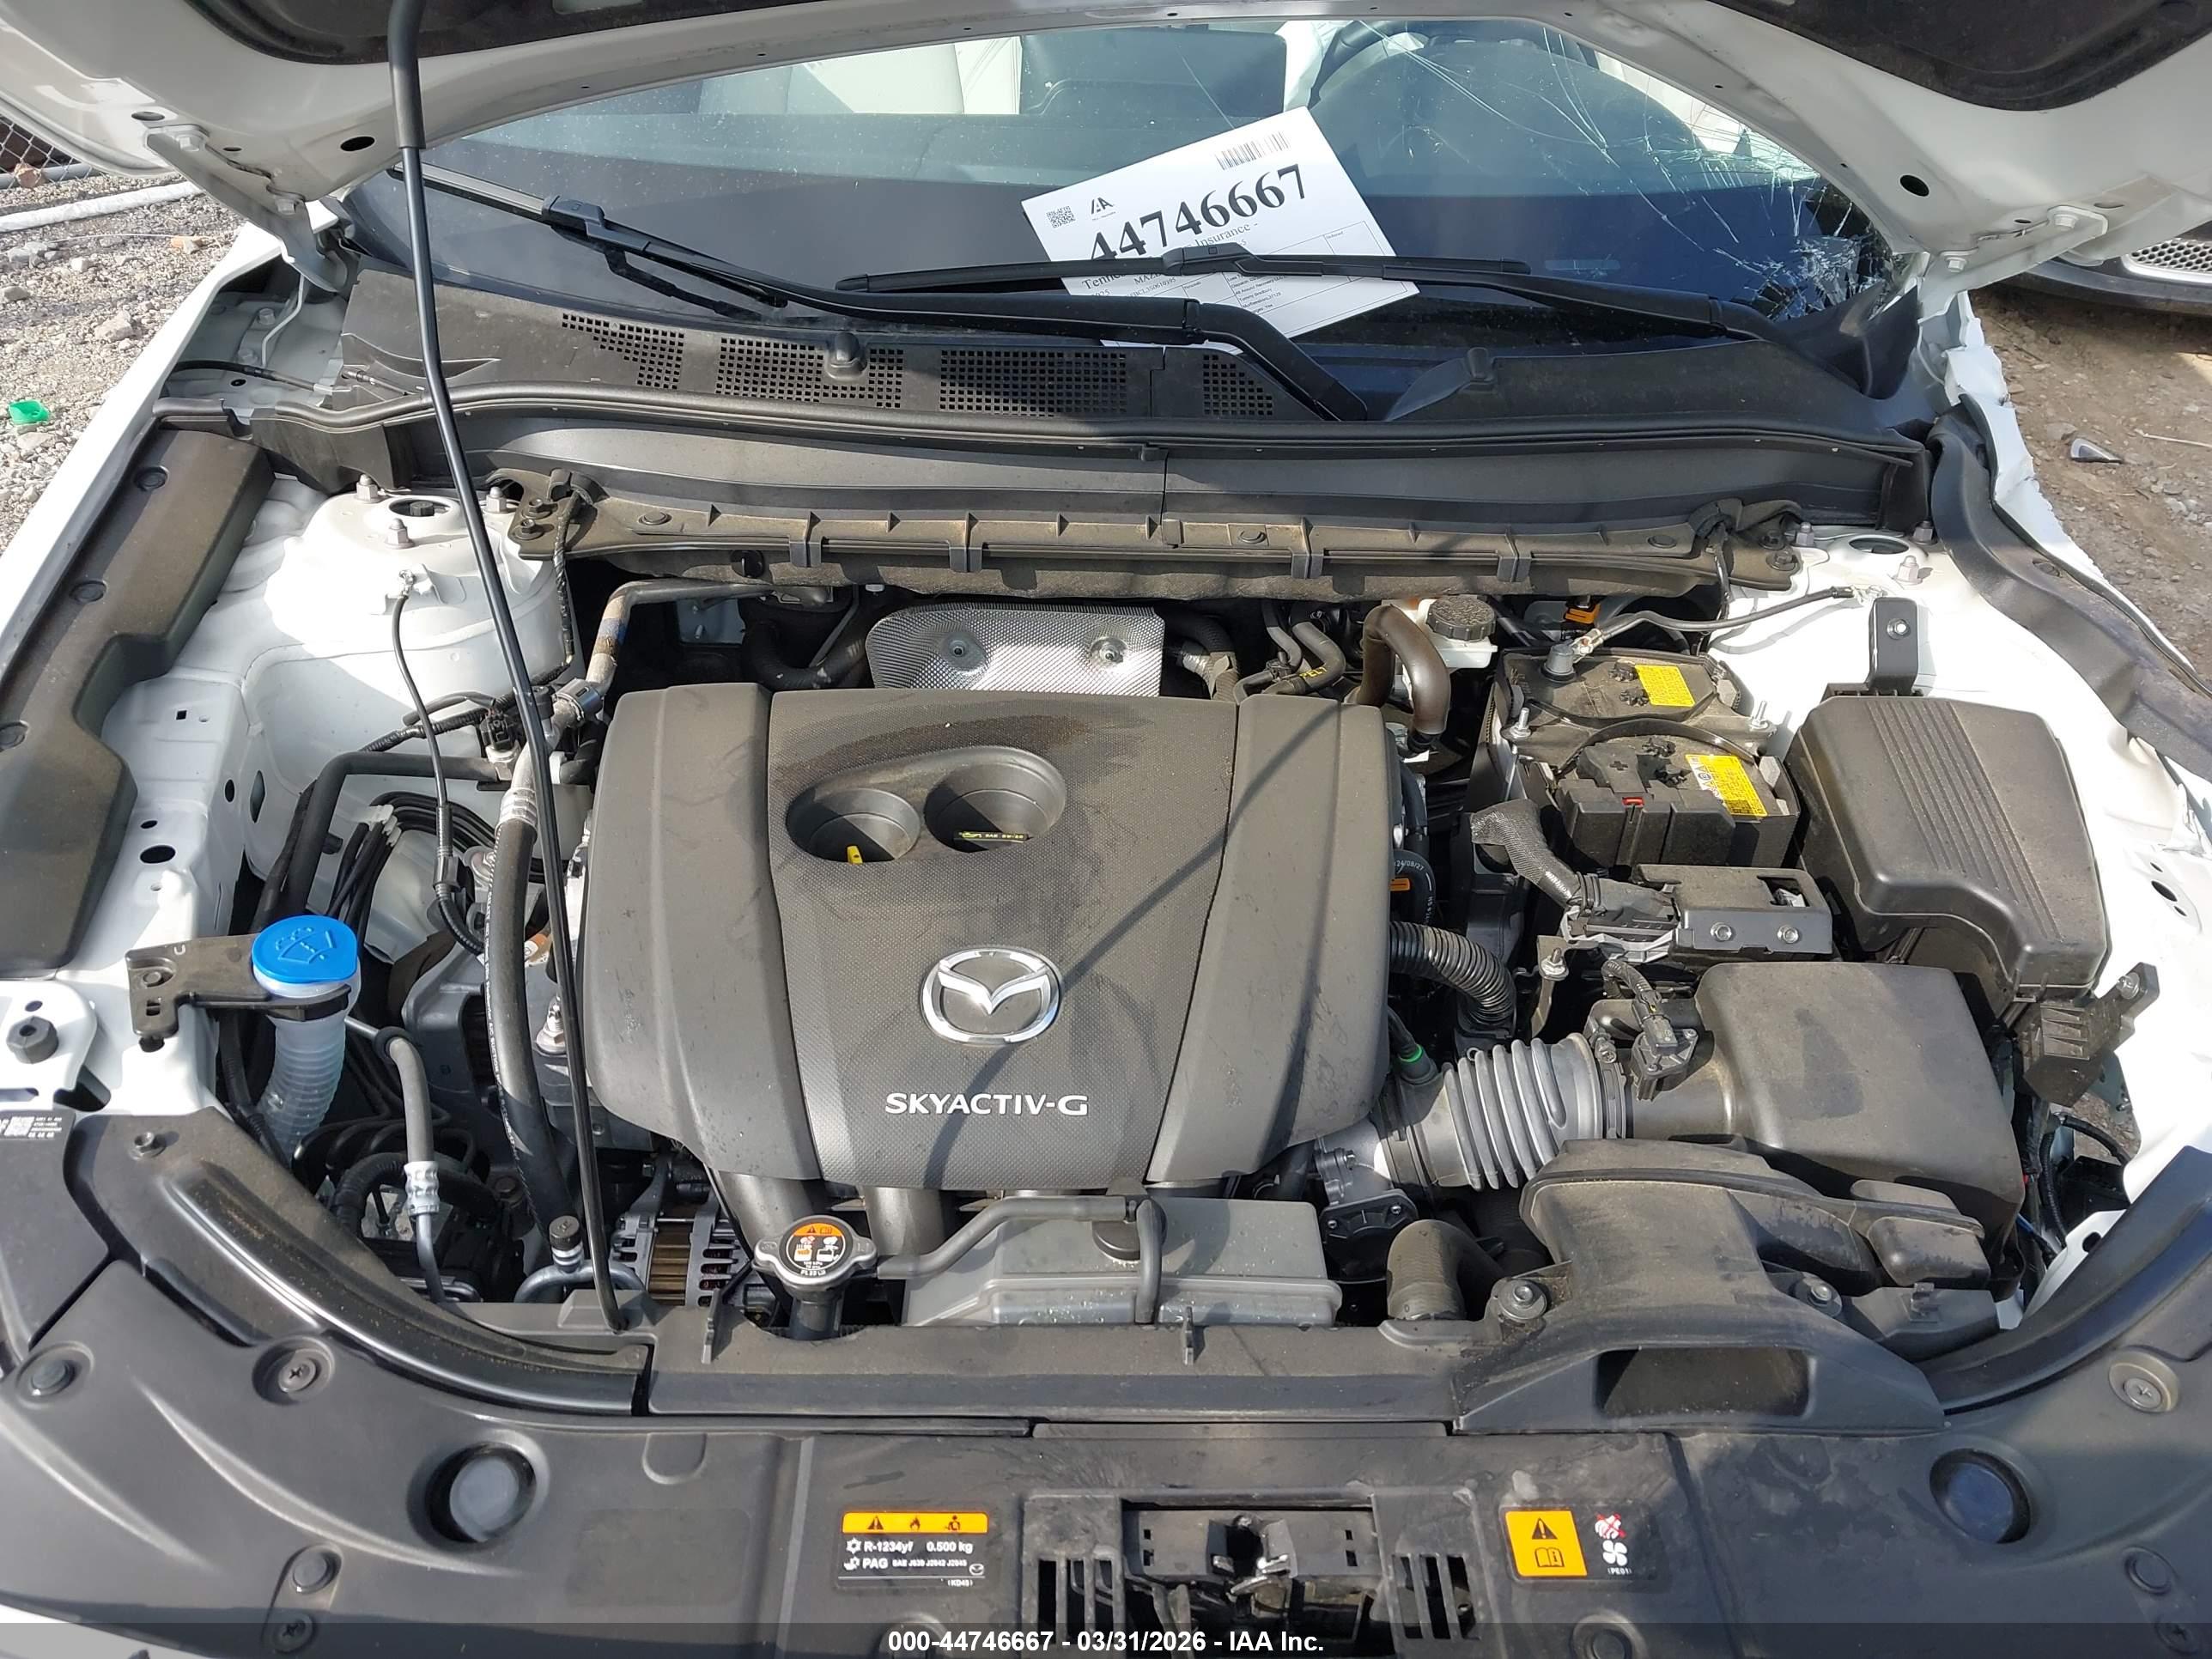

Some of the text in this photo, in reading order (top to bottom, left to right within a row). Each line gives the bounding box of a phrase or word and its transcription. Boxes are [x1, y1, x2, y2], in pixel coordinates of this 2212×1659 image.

[1091, 163, 1306, 260] 44746667
[1195, 223, 1251, 246] Insurance
[1082, 274, 1127, 290] Tenne
[884, 1092, 1088, 1115] SKYACTIV-G
[864, 1540, 974, 1555] R-1234yf 0.500 kg
[862, 1558, 889, 1570] PAG
